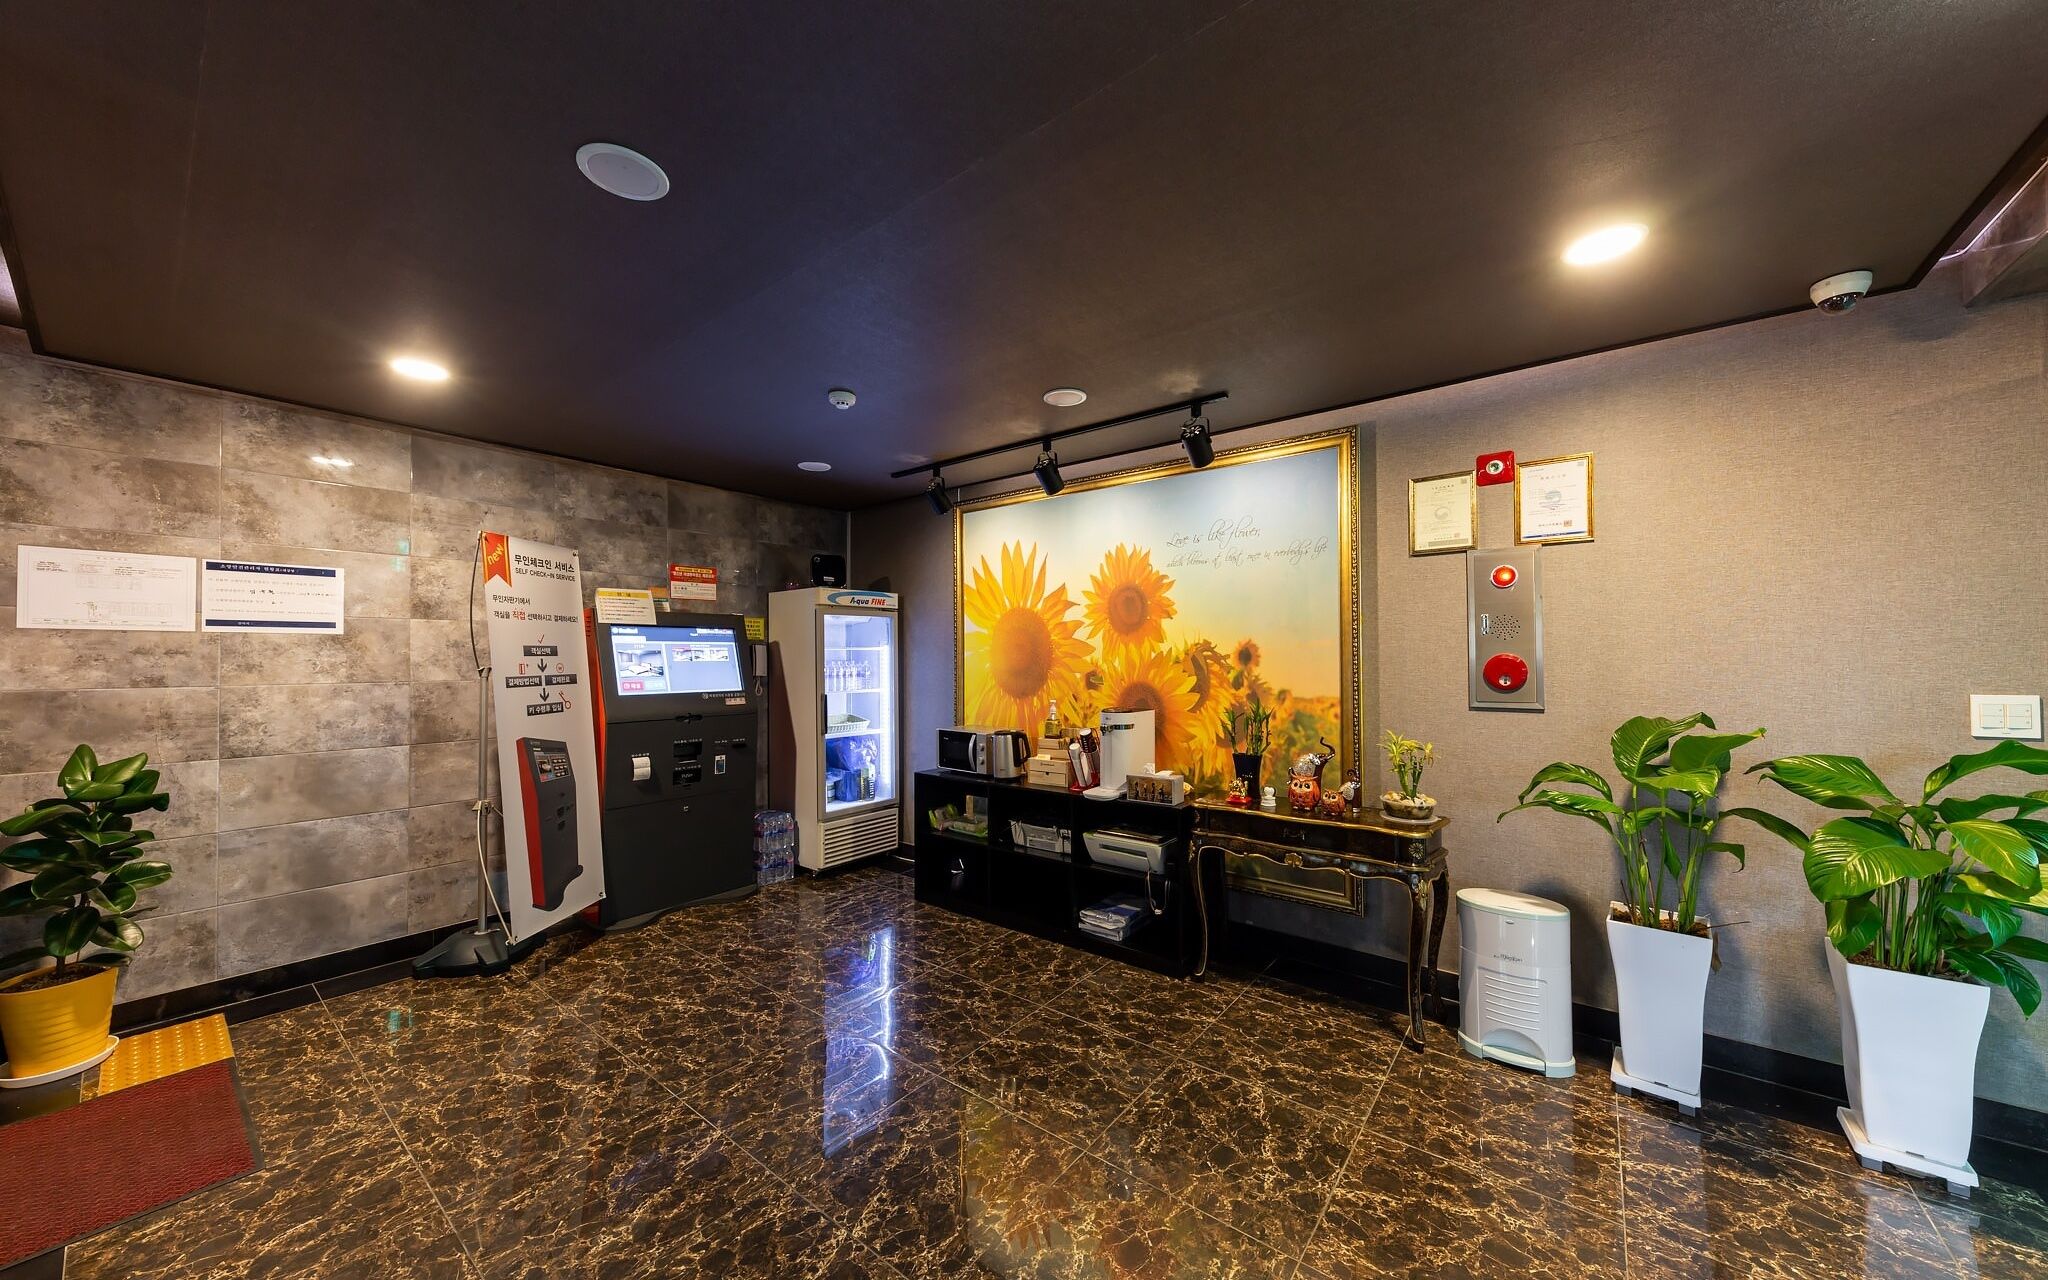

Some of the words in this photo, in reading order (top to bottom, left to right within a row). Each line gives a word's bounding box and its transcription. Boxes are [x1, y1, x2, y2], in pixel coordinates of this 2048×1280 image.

[1167, 531, 1189, 548] Love
[1207, 518, 1235, 544] like
[487, 543, 504, 565] new
[514, 554, 552, 570] 무인체크인
[554, 560, 575, 573] 서비스
[515, 567, 528, 575] SELF
[529, 570, 555, 579] CHECK-IN
[555, 573, 576, 582] SERVICE
[492, 594, 531, 606] 무인자판기에서
[870, 597, 887, 606] FINE
[493, 610, 510, 620] 객실을
[512, 609, 526, 620] 직접
[527, 613, 552, 623] 선택하시고
[531, 647, 551, 655] 객실선택
[508, 677, 540, 686] 결제방법선택
[528, 706, 535, 714] 키
[536, 704, 550, 714] 수령후
[551, 703, 562, 712] 입실
